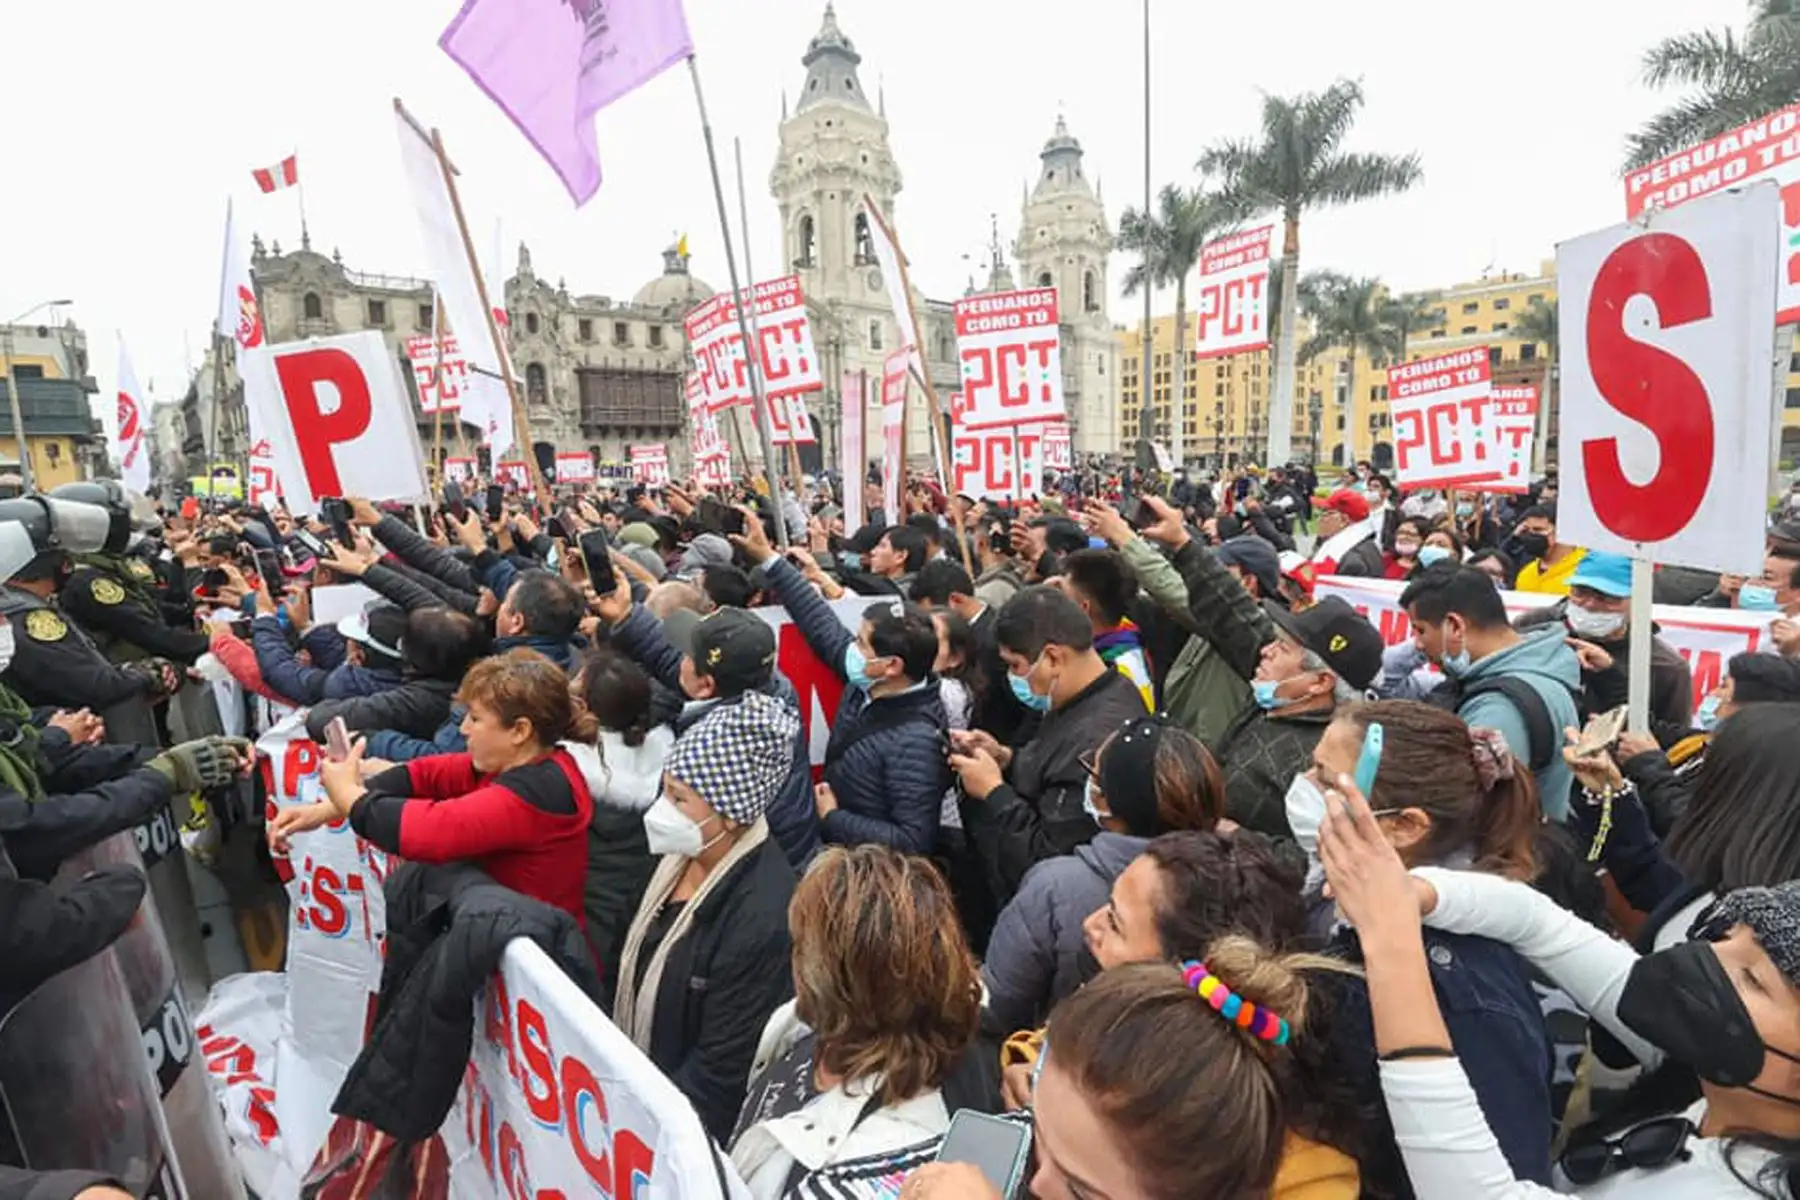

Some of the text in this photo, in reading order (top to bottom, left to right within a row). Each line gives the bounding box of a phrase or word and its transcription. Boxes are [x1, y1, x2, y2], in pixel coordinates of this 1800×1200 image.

[1630, 110, 1800, 194] PERUANO
[1644, 157, 1748, 210] COMO
[957, 291, 1054, 315] PERUANOS
[965, 312, 1021, 332] COMO
[1198, 272, 1267, 340] PCT
[960, 339, 1058, 412] PCT
[1389, 349, 1486, 381] PERUANOS
[1398, 373, 1452, 396] COMO
[1581, 232, 1715, 544] S
[273, 347, 373, 503] P
[1394, 396, 1490, 471] PCT
[954, 434, 1040, 491] PCT
